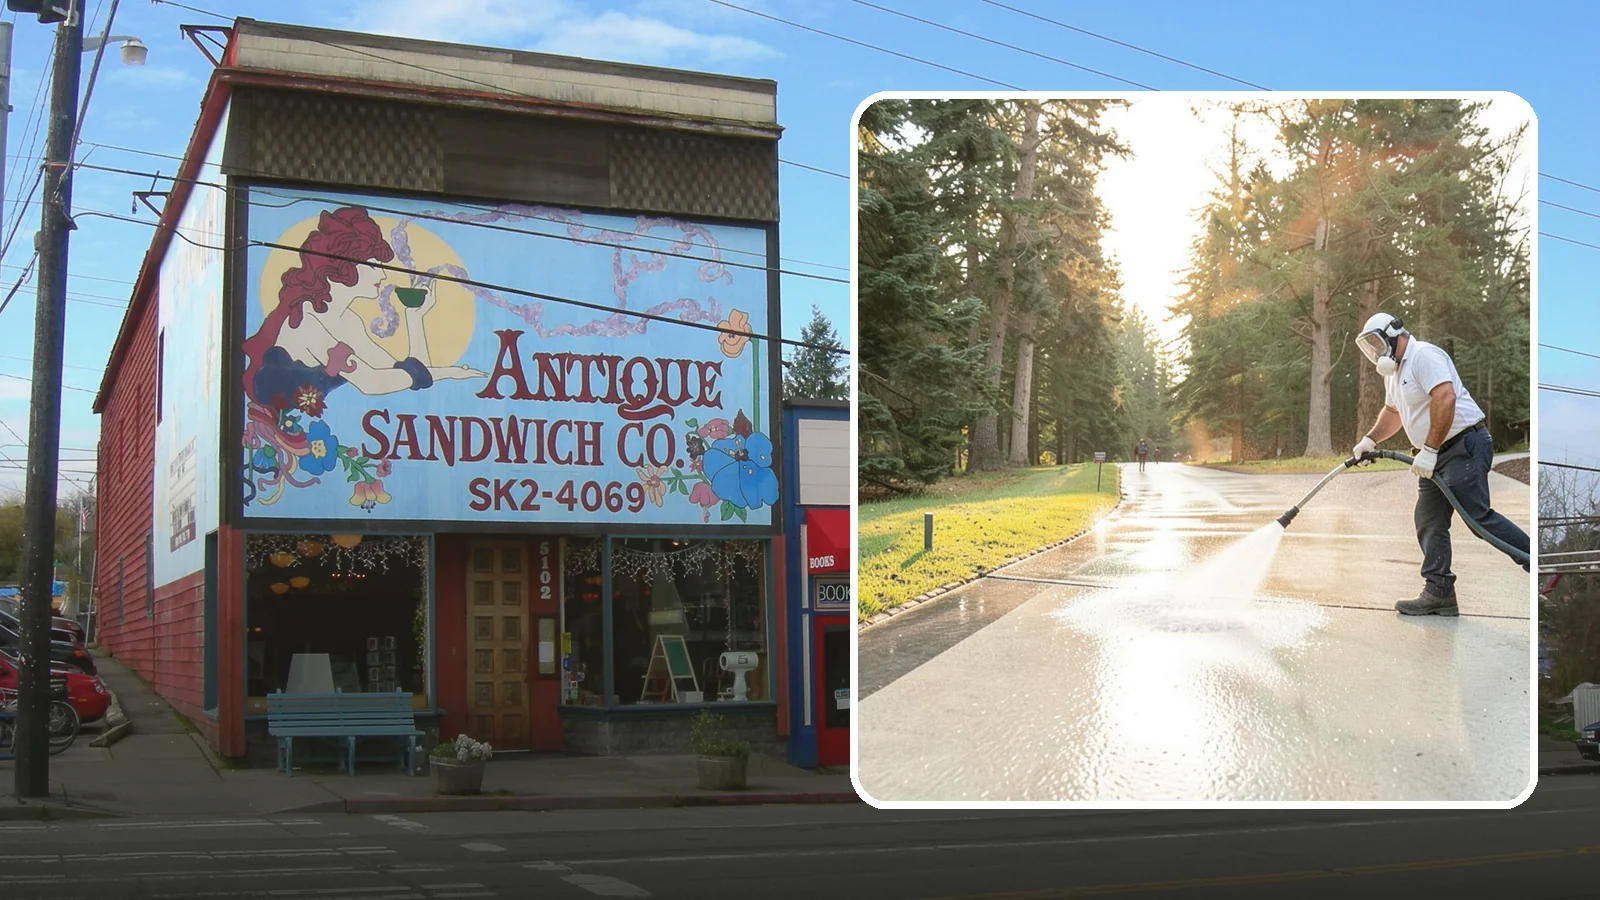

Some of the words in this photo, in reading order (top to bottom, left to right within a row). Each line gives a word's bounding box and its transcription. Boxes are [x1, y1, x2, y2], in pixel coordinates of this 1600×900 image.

[476, 329, 723, 420] ANTIQUE
[361, 408, 604, 467] SANDWICH
[617, 421, 685, 469] CO.
[468, 477, 645, 512] SK2-4069
[539, 541, 551, 600] 5102
[809, 555, 835, 569] BOOKS
